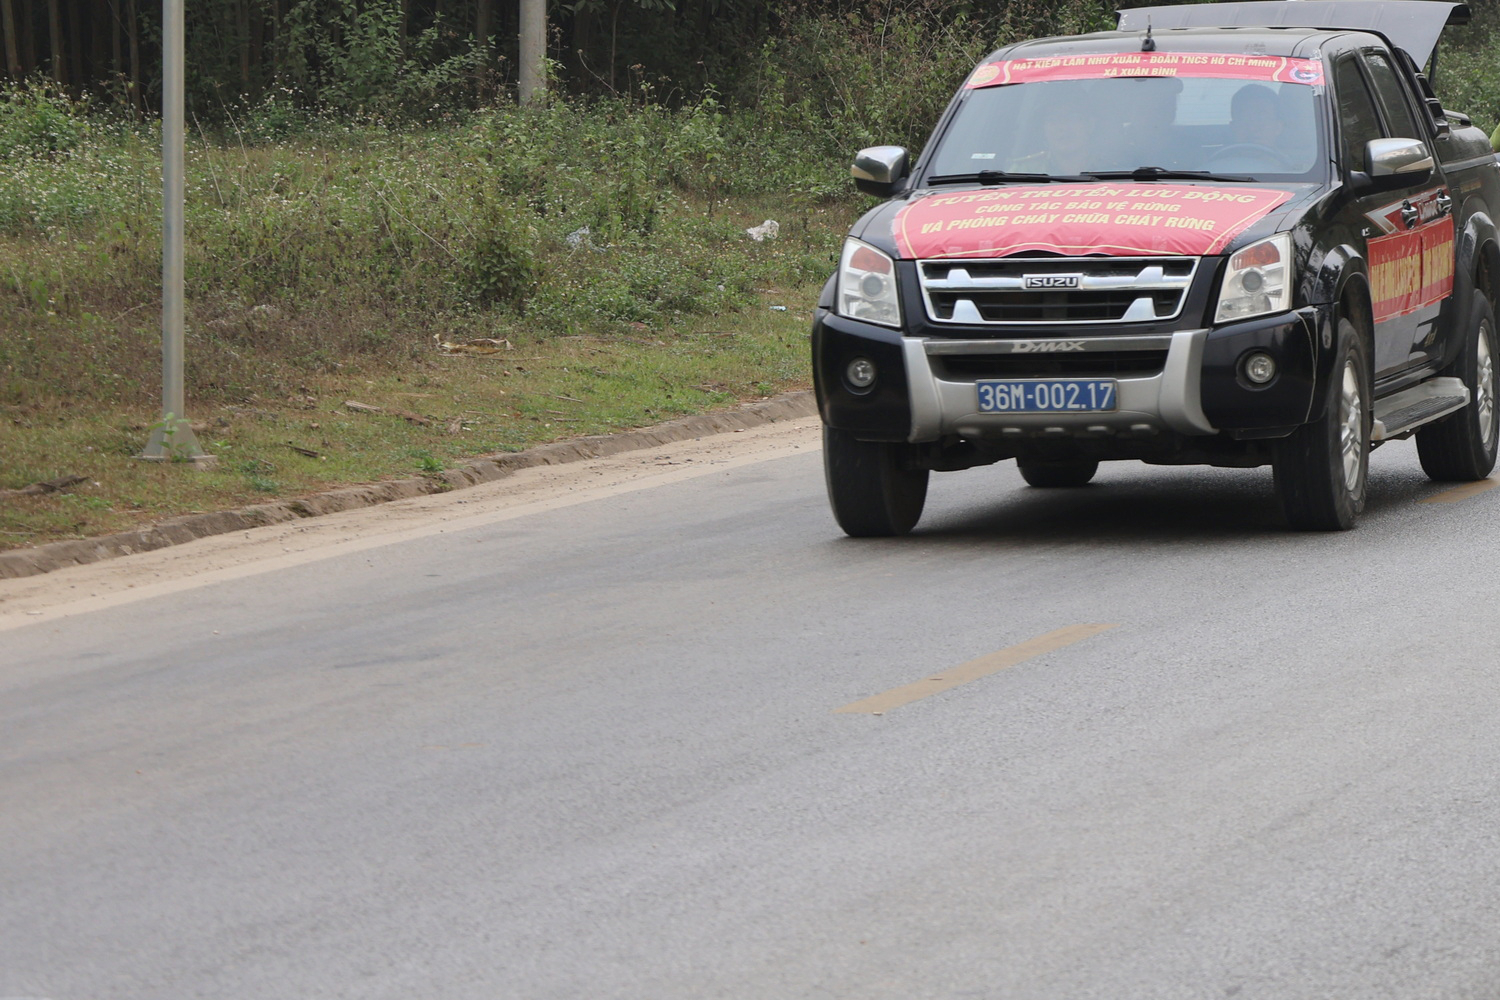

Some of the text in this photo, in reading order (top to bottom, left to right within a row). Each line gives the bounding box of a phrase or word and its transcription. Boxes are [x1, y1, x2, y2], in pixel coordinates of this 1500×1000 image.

[1012, 61, 1034, 71] HẠT
[1088, 56, 1111, 66] NHƯ
[1112, 55, 1142, 65] XUÂN
[1150, 55, 1180, 65] ĐOÀN
[1182, 56, 1209, 65] TNCS
[1211, 55, 1226, 66] HỒ
[1227, 55, 1247, 67] CHÍ
[1248, 58, 1277, 69] MINH
[1120, 66, 1150, 76] XUÂN
[1151, 66, 1178, 76] BÌNH
[930, 185, 1258, 208] TUYÊN TRUYỀN LƯU ĐỘNG
[975, 199, 1182, 214] CÔNG TÁC BẢO VỆ RỪNG
[921, 212, 1217, 235] VÀ PHÒNG CHÁY CHỮA CHÁY RỪNG
[1026, 277, 1078, 288] ISUZU
[1011, 341, 1088, 353] D-MAX
[979, 382, 1114, 411] 36M-002.17
